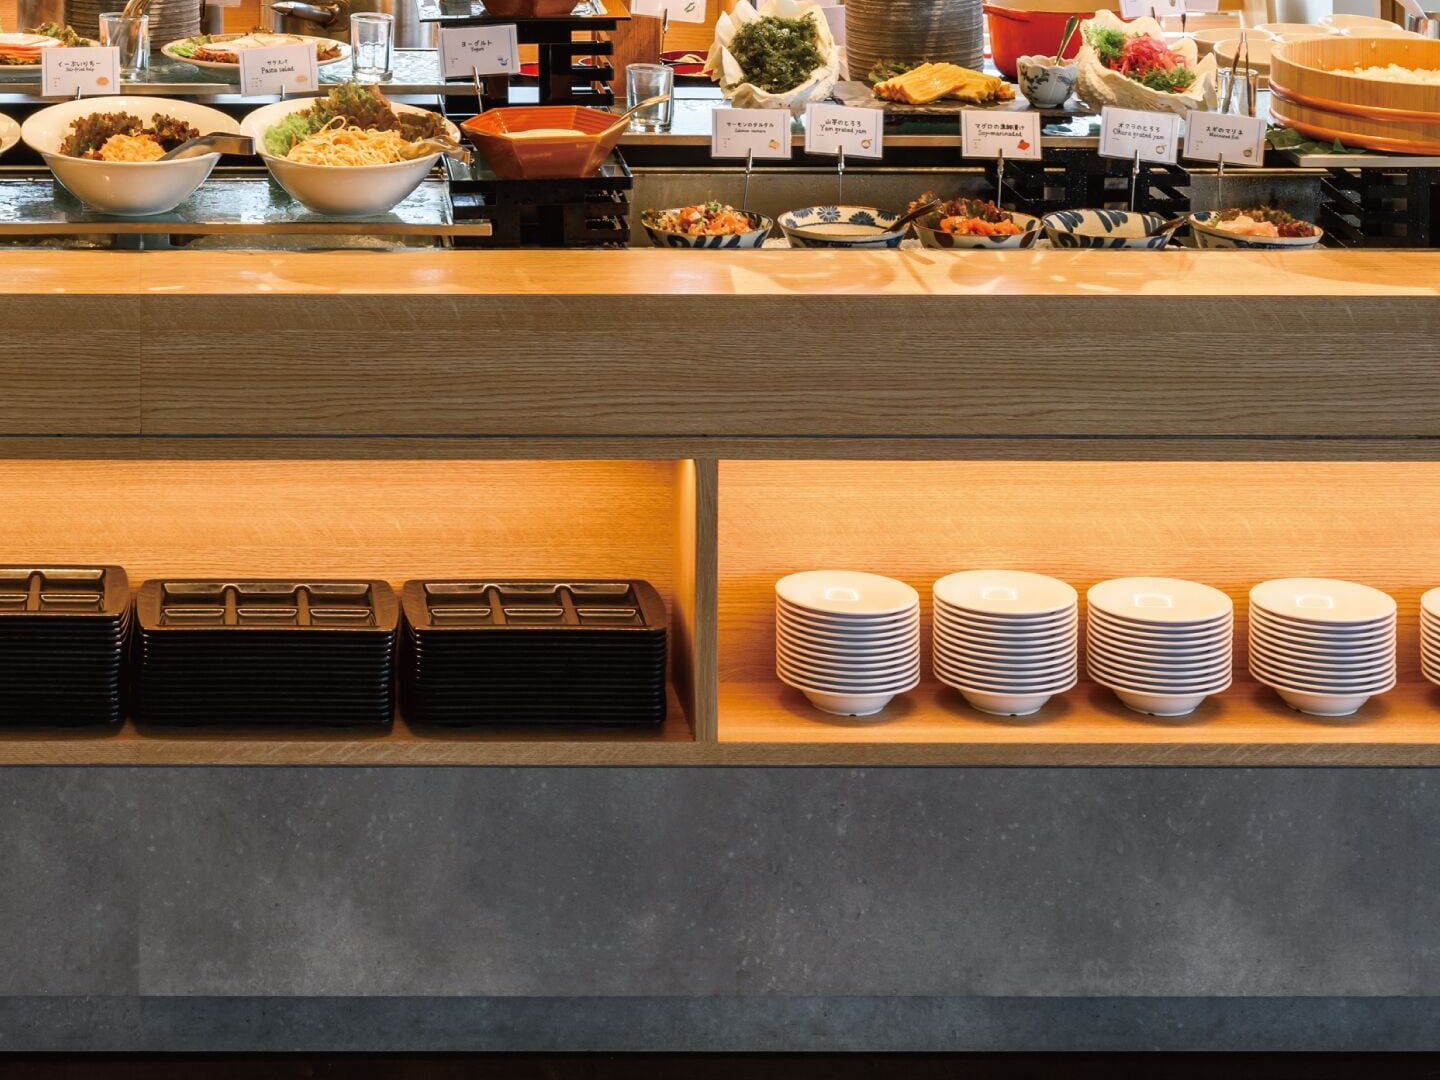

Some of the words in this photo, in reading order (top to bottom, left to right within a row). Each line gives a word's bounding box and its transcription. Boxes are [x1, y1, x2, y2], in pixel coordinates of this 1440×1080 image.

[261, 66, 278, 74] Pasta
[820, 124, 833, 132] Yam
[1118, 122, 1161, 132] オクラのとろろ
